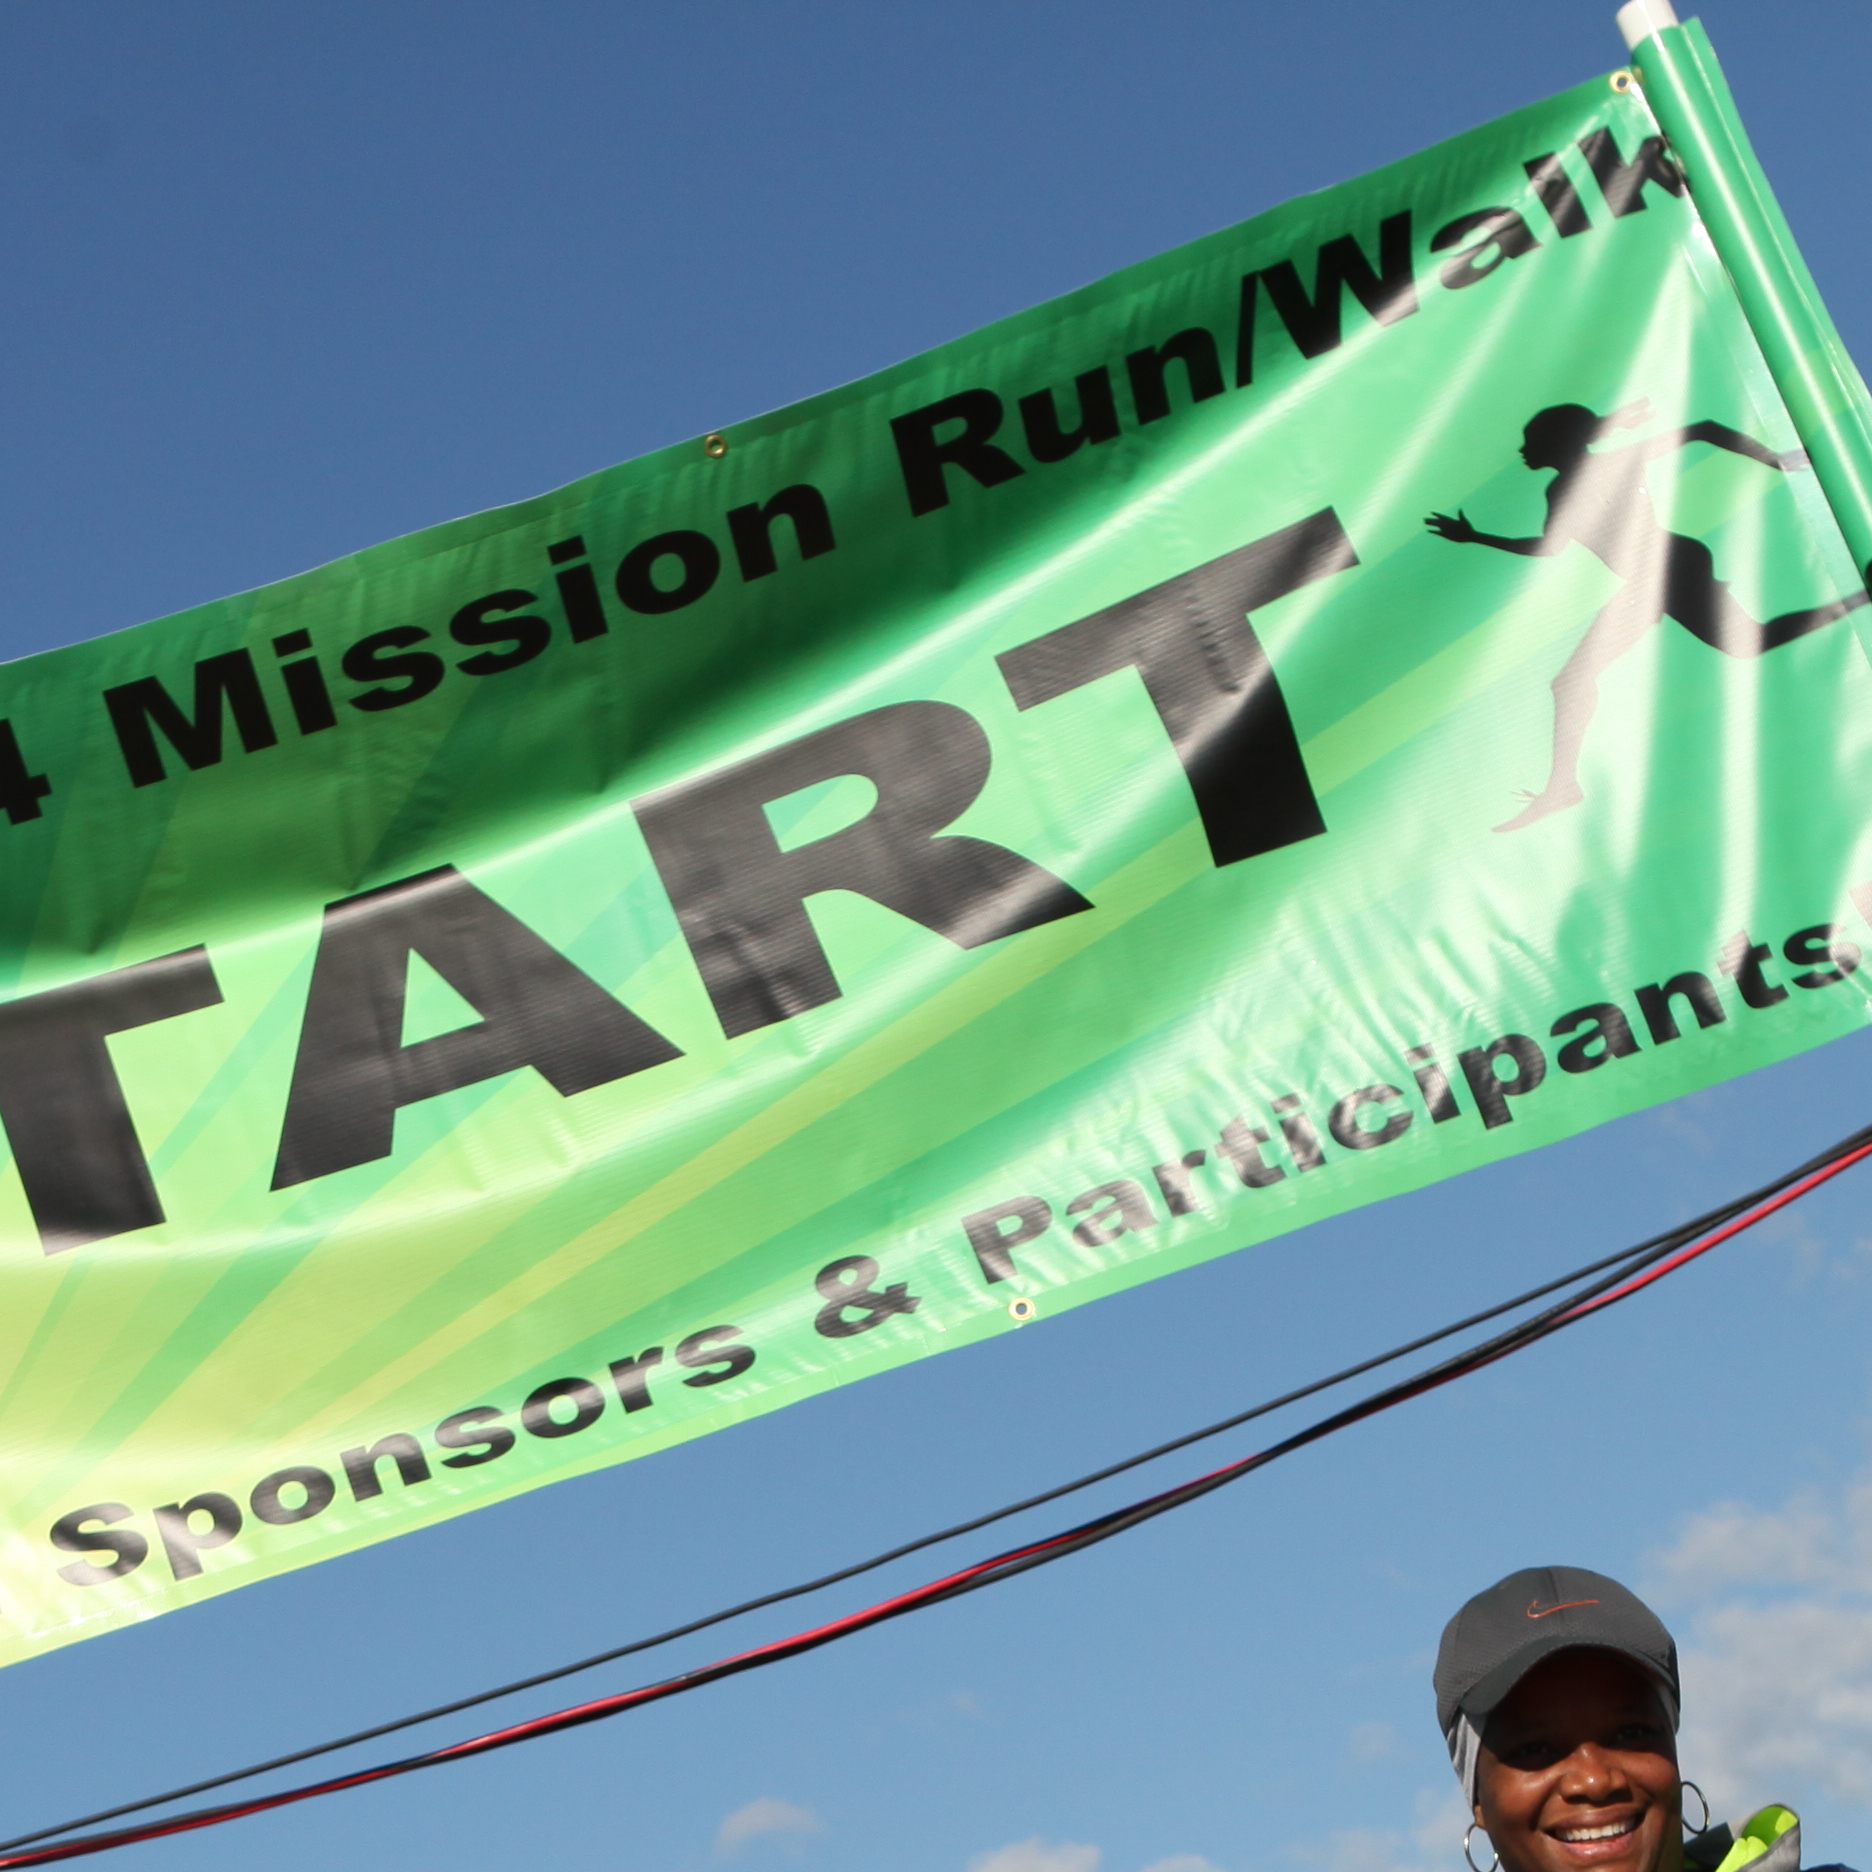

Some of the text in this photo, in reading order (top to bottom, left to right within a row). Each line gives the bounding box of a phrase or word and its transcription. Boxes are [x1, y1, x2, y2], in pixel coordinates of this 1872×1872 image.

[105, 481, 836, 790] Mission
[890, 124, 1693, 517] Run/Walk
[49, 1323, 760, 1587] Sponsors
[813, 1255, 925, 1339] &
